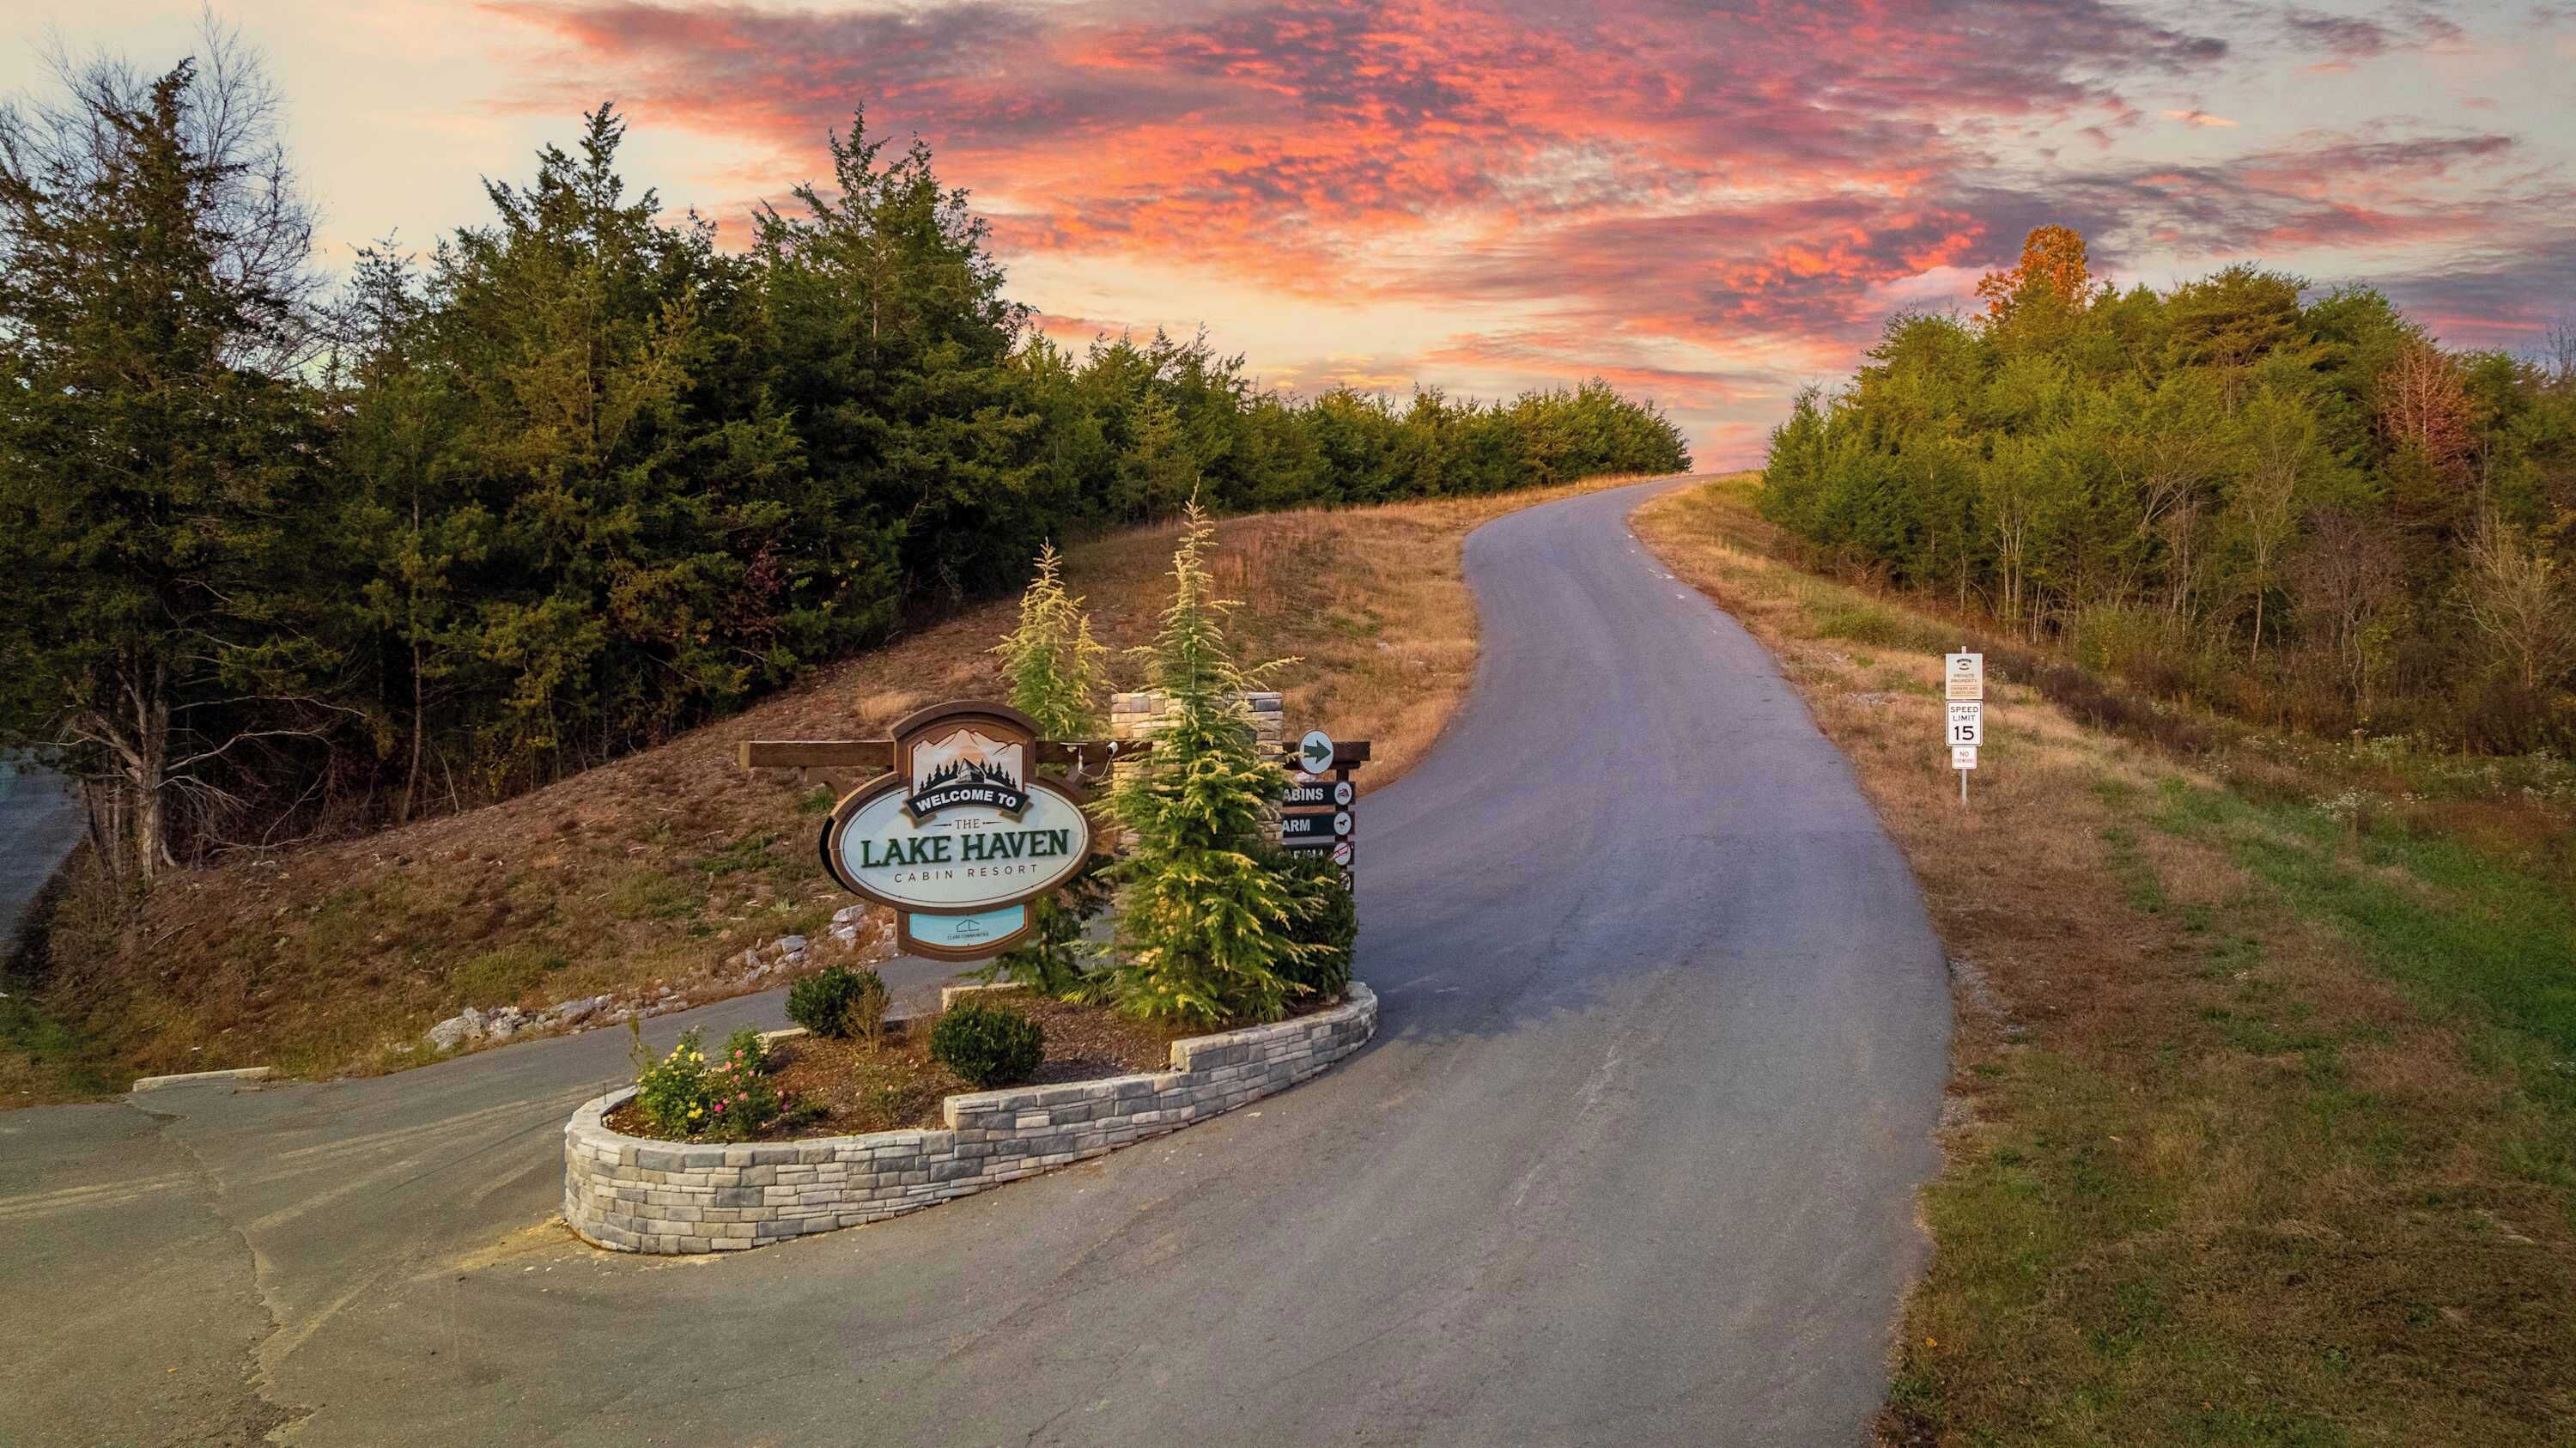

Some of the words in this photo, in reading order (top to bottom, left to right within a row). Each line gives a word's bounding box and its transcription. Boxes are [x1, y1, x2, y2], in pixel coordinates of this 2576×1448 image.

[1953, 726, 1974, 740] 15
[916, 789, 994, 812] WELCOME
[998, 793, 1018, 808] TO
[1282, 788, 1324, 802] ABINS
[954, 818, 981, 830] THE
[1282, 818, 1311, 832] ARM
[860, 835, 952, 868] LAKE
[960, 829, 1070, 861] HAVEN
[894, 869, 954, 884] CABIN
[968, 864, 1038, 878] RESORT
